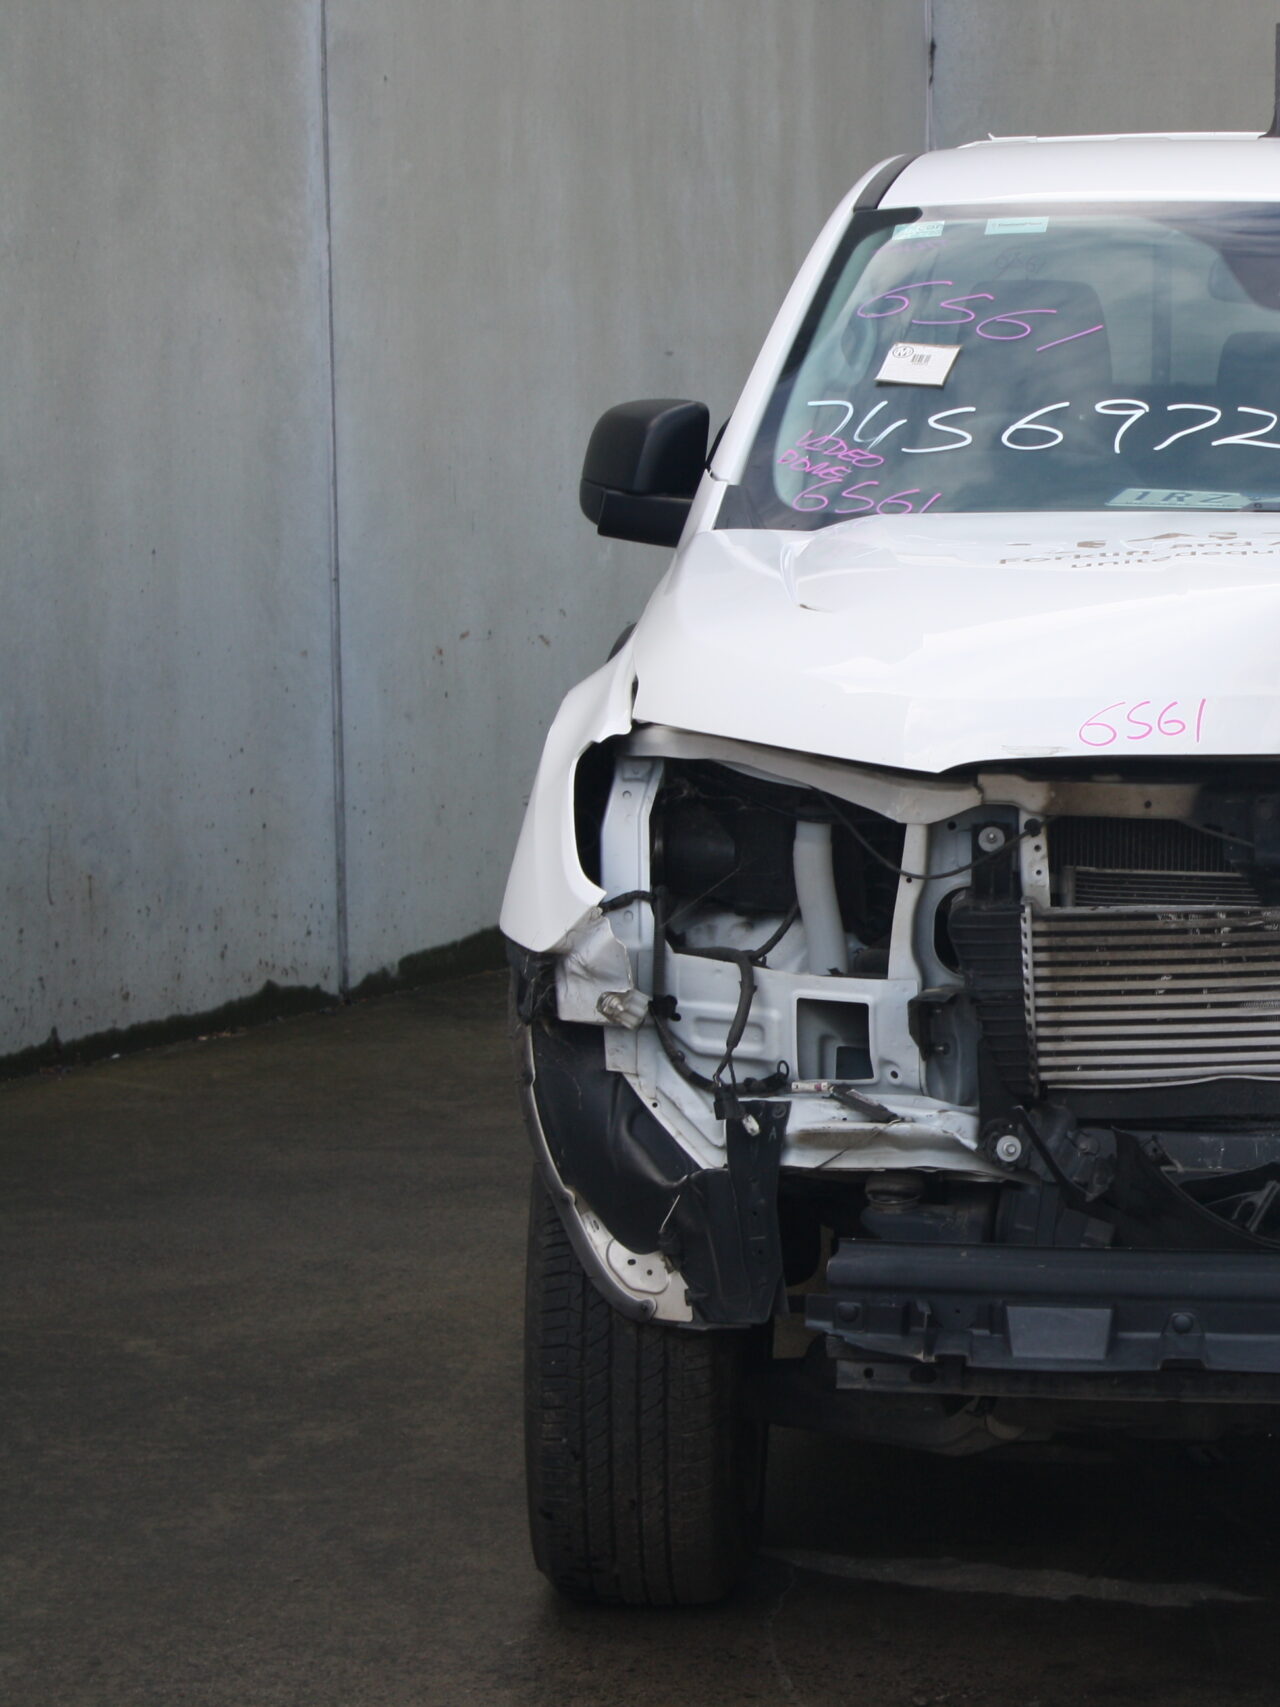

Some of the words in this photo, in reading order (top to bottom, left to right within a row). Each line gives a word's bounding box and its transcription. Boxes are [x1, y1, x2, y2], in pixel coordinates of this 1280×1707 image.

[856, 280, 1103, 352] 6561
[1170, 540, 1253, 550] and
[1079, 698, 1207, 747] 6561
